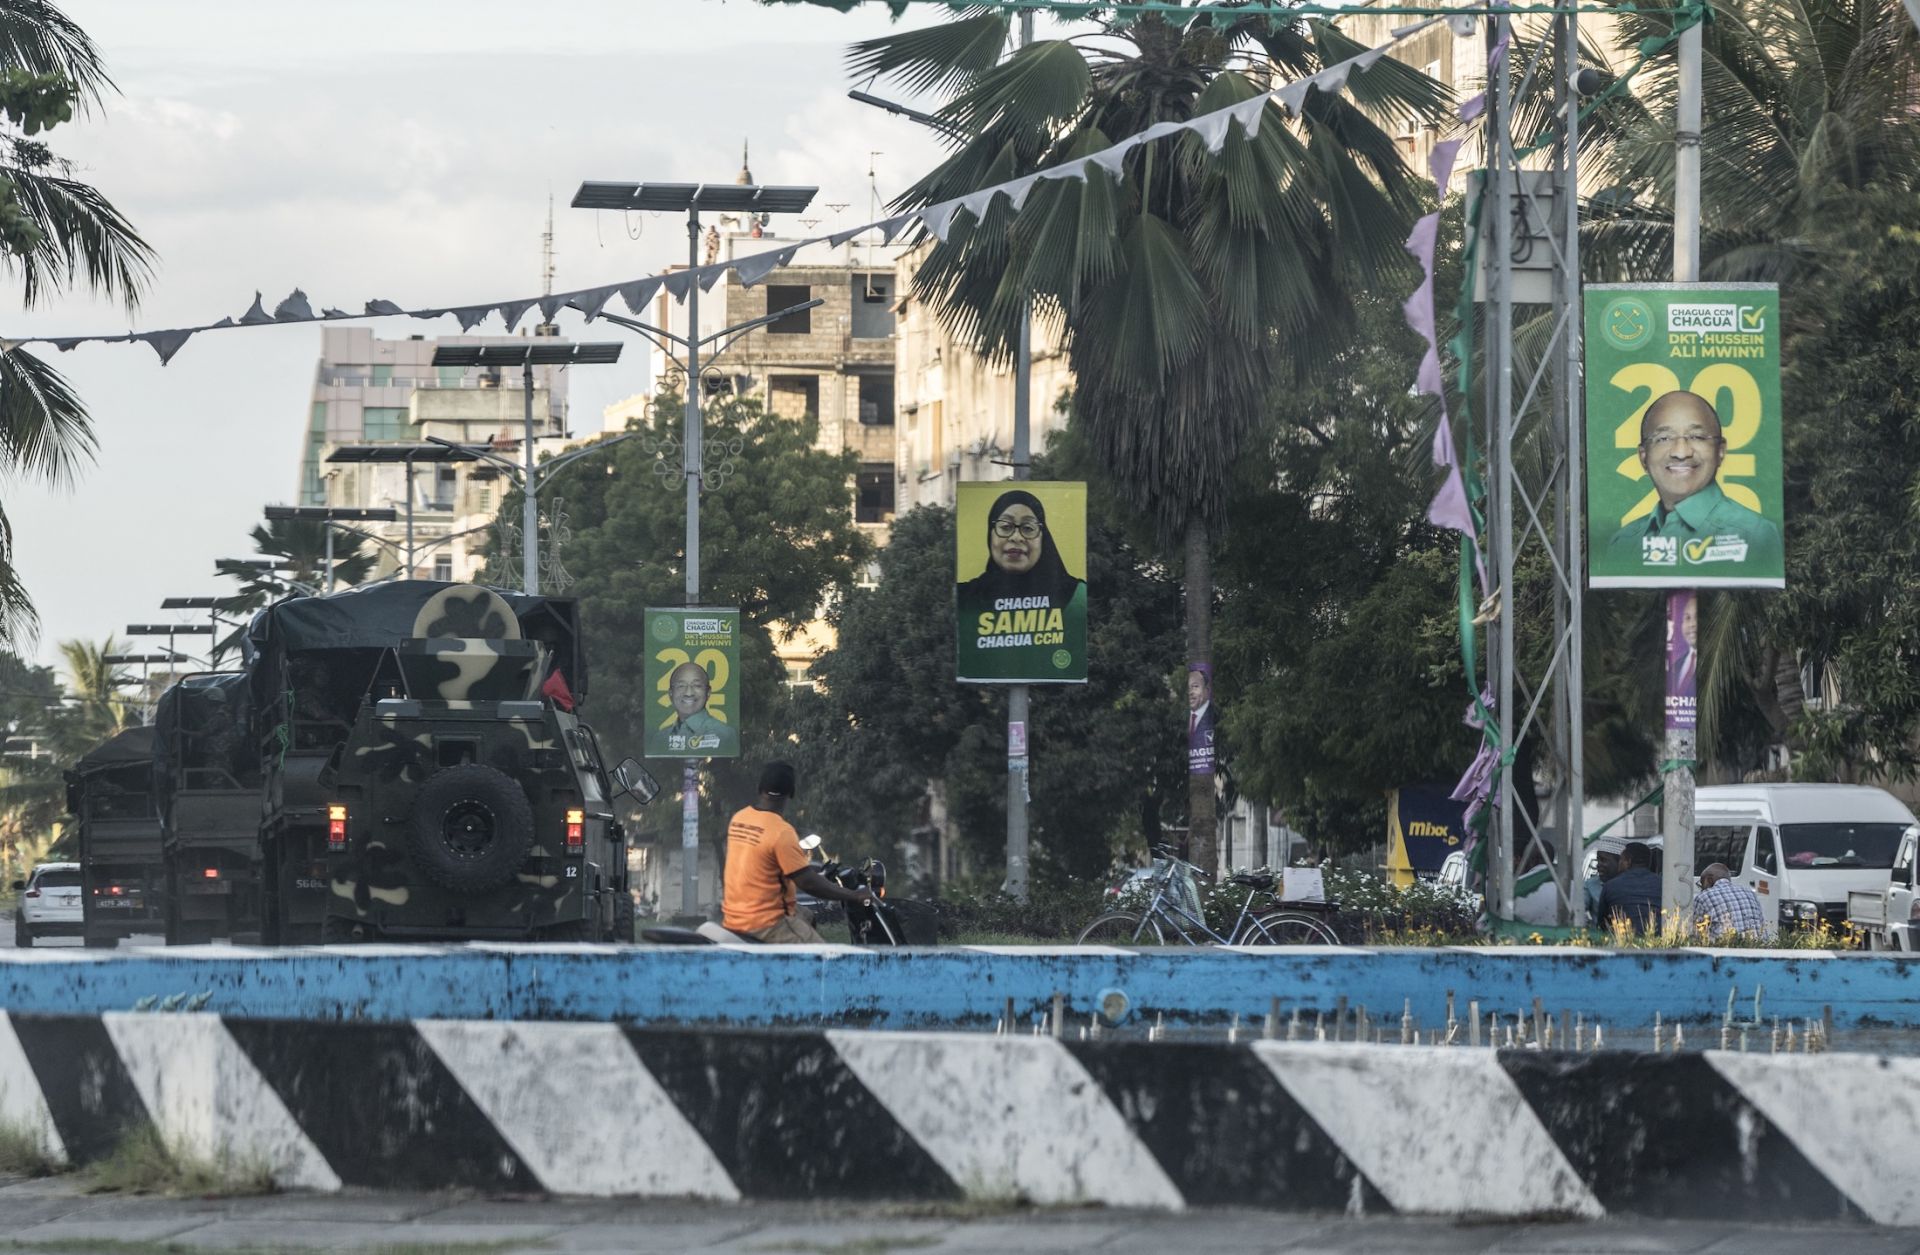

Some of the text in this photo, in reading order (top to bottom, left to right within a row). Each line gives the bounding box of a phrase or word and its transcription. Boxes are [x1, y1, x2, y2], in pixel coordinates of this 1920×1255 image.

[1672, 317, 1732, 327] CHAGUA
[1705, 334, 1764, 344] HUSSEIN
[1670, 346, 1764, 358] ALI MWINYI
[994, 596, 1050, 611] CHAGUA
[977, 607, 1064, 635] SAMIA
[977, 632, 1064, 649] CHAGUA CCM
[566, 866, 577, 877] 12
